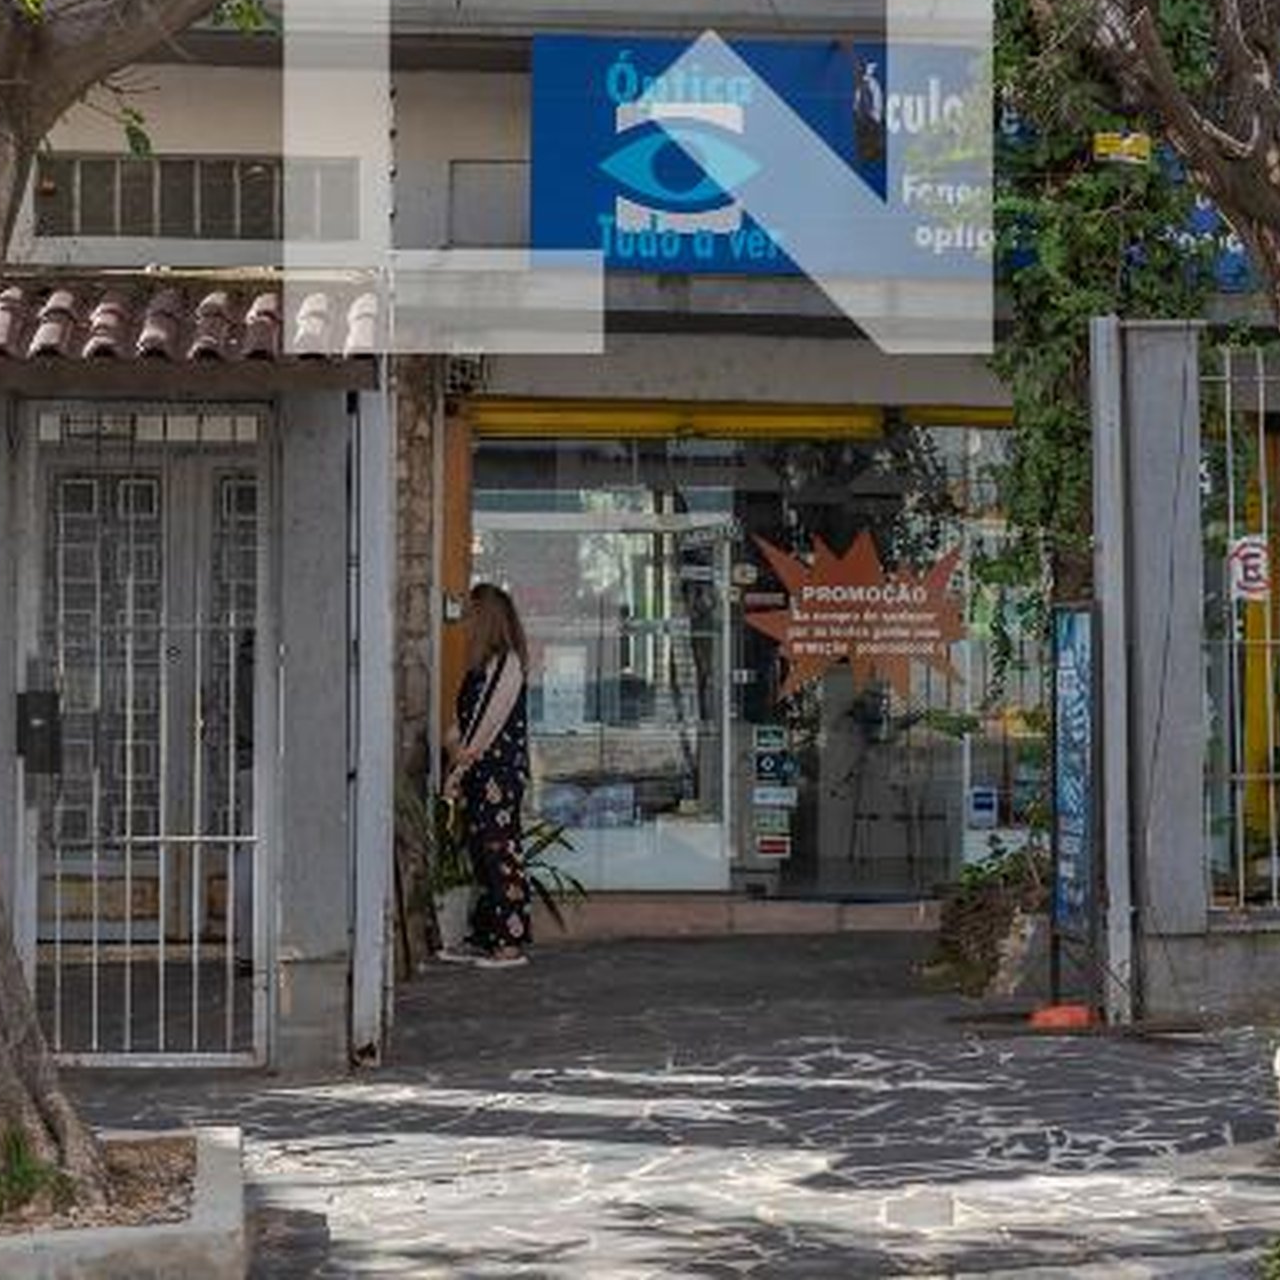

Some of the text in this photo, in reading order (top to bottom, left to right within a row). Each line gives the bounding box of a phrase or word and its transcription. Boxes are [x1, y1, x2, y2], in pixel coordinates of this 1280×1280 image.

[598, 214, 681, 259] Tudo
[693, 229, 715, 259] a
[802, 583, 928, 604] PROMOÇÃO
